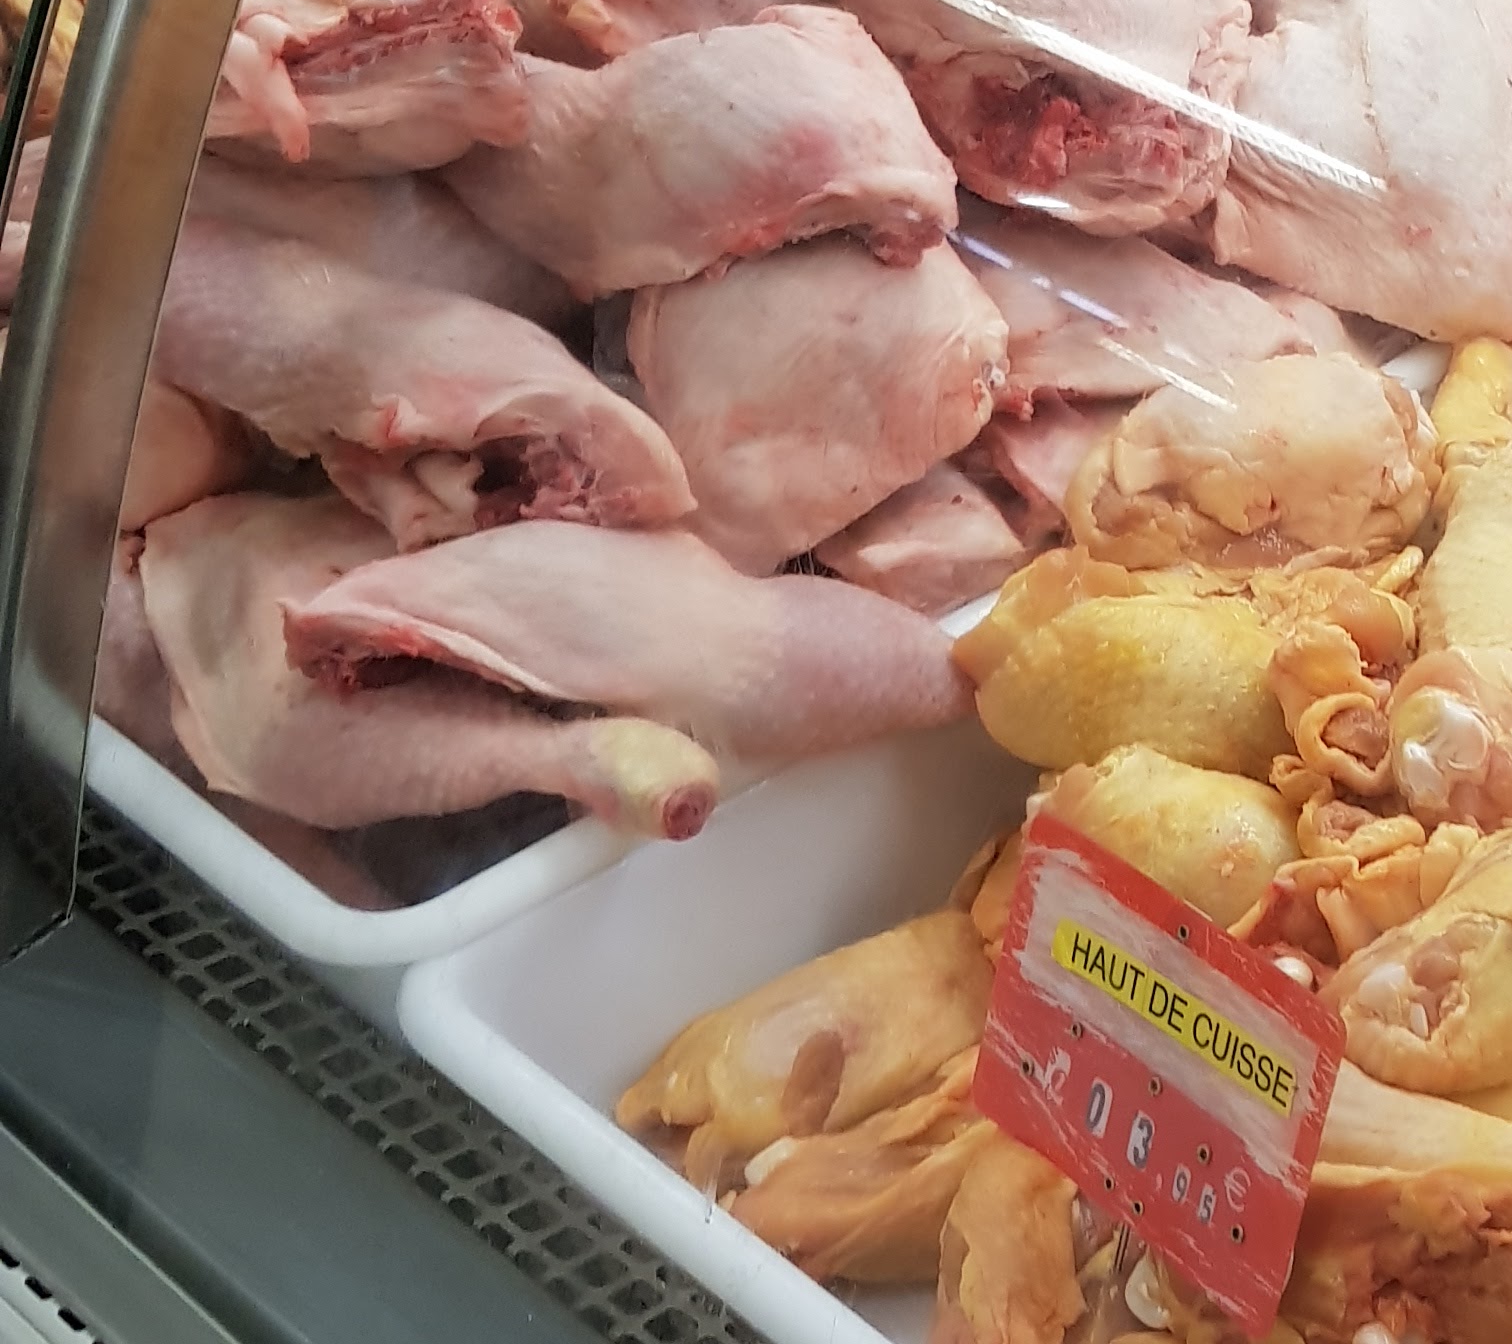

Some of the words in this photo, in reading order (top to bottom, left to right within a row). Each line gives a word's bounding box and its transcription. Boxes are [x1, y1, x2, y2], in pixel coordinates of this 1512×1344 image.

[1070, 932, 1145, 1001] HAUT
[1147, 980, 1189, 1035] DE
[1192, 1013, 1293, 1108] CUISSE
